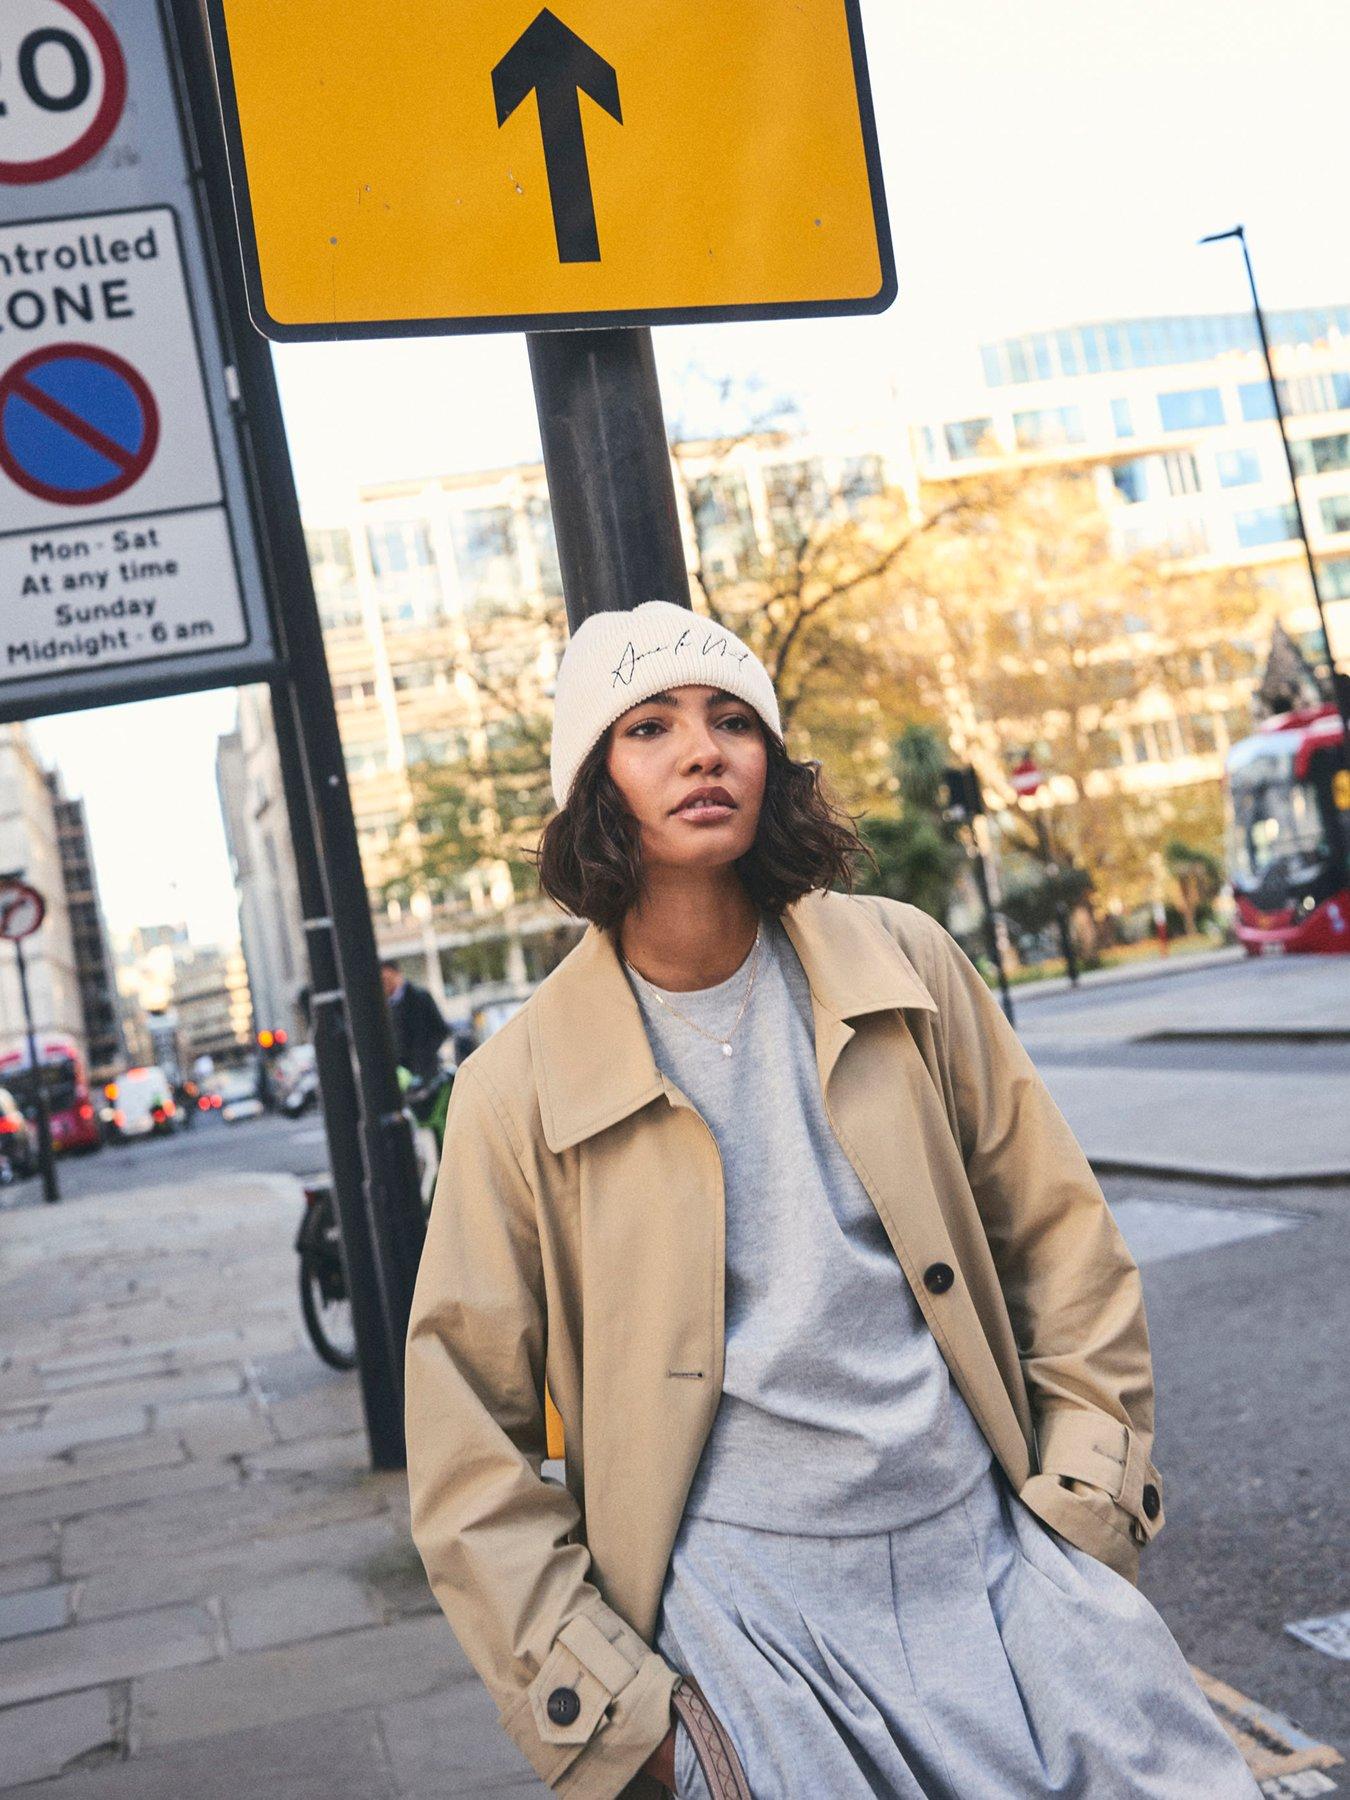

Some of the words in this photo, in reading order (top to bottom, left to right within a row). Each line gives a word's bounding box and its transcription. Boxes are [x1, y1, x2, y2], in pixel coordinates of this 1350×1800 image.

[0, 27, 91, 113] 0
[0, 279, 134, 333] ONE
[30, 541, 89, 563] Mon
[112, 529, 158, 552] Sat
[22, 574, 51, 597] At
[63, 569, 109, 590] any
[119, 559, 178, 582] time
[56, 597, 155, 626] Sunday
[7, 628, 128, 665] Midnight
[151, 621, 167, 643] 6
[176, 619, 214, 640] am
